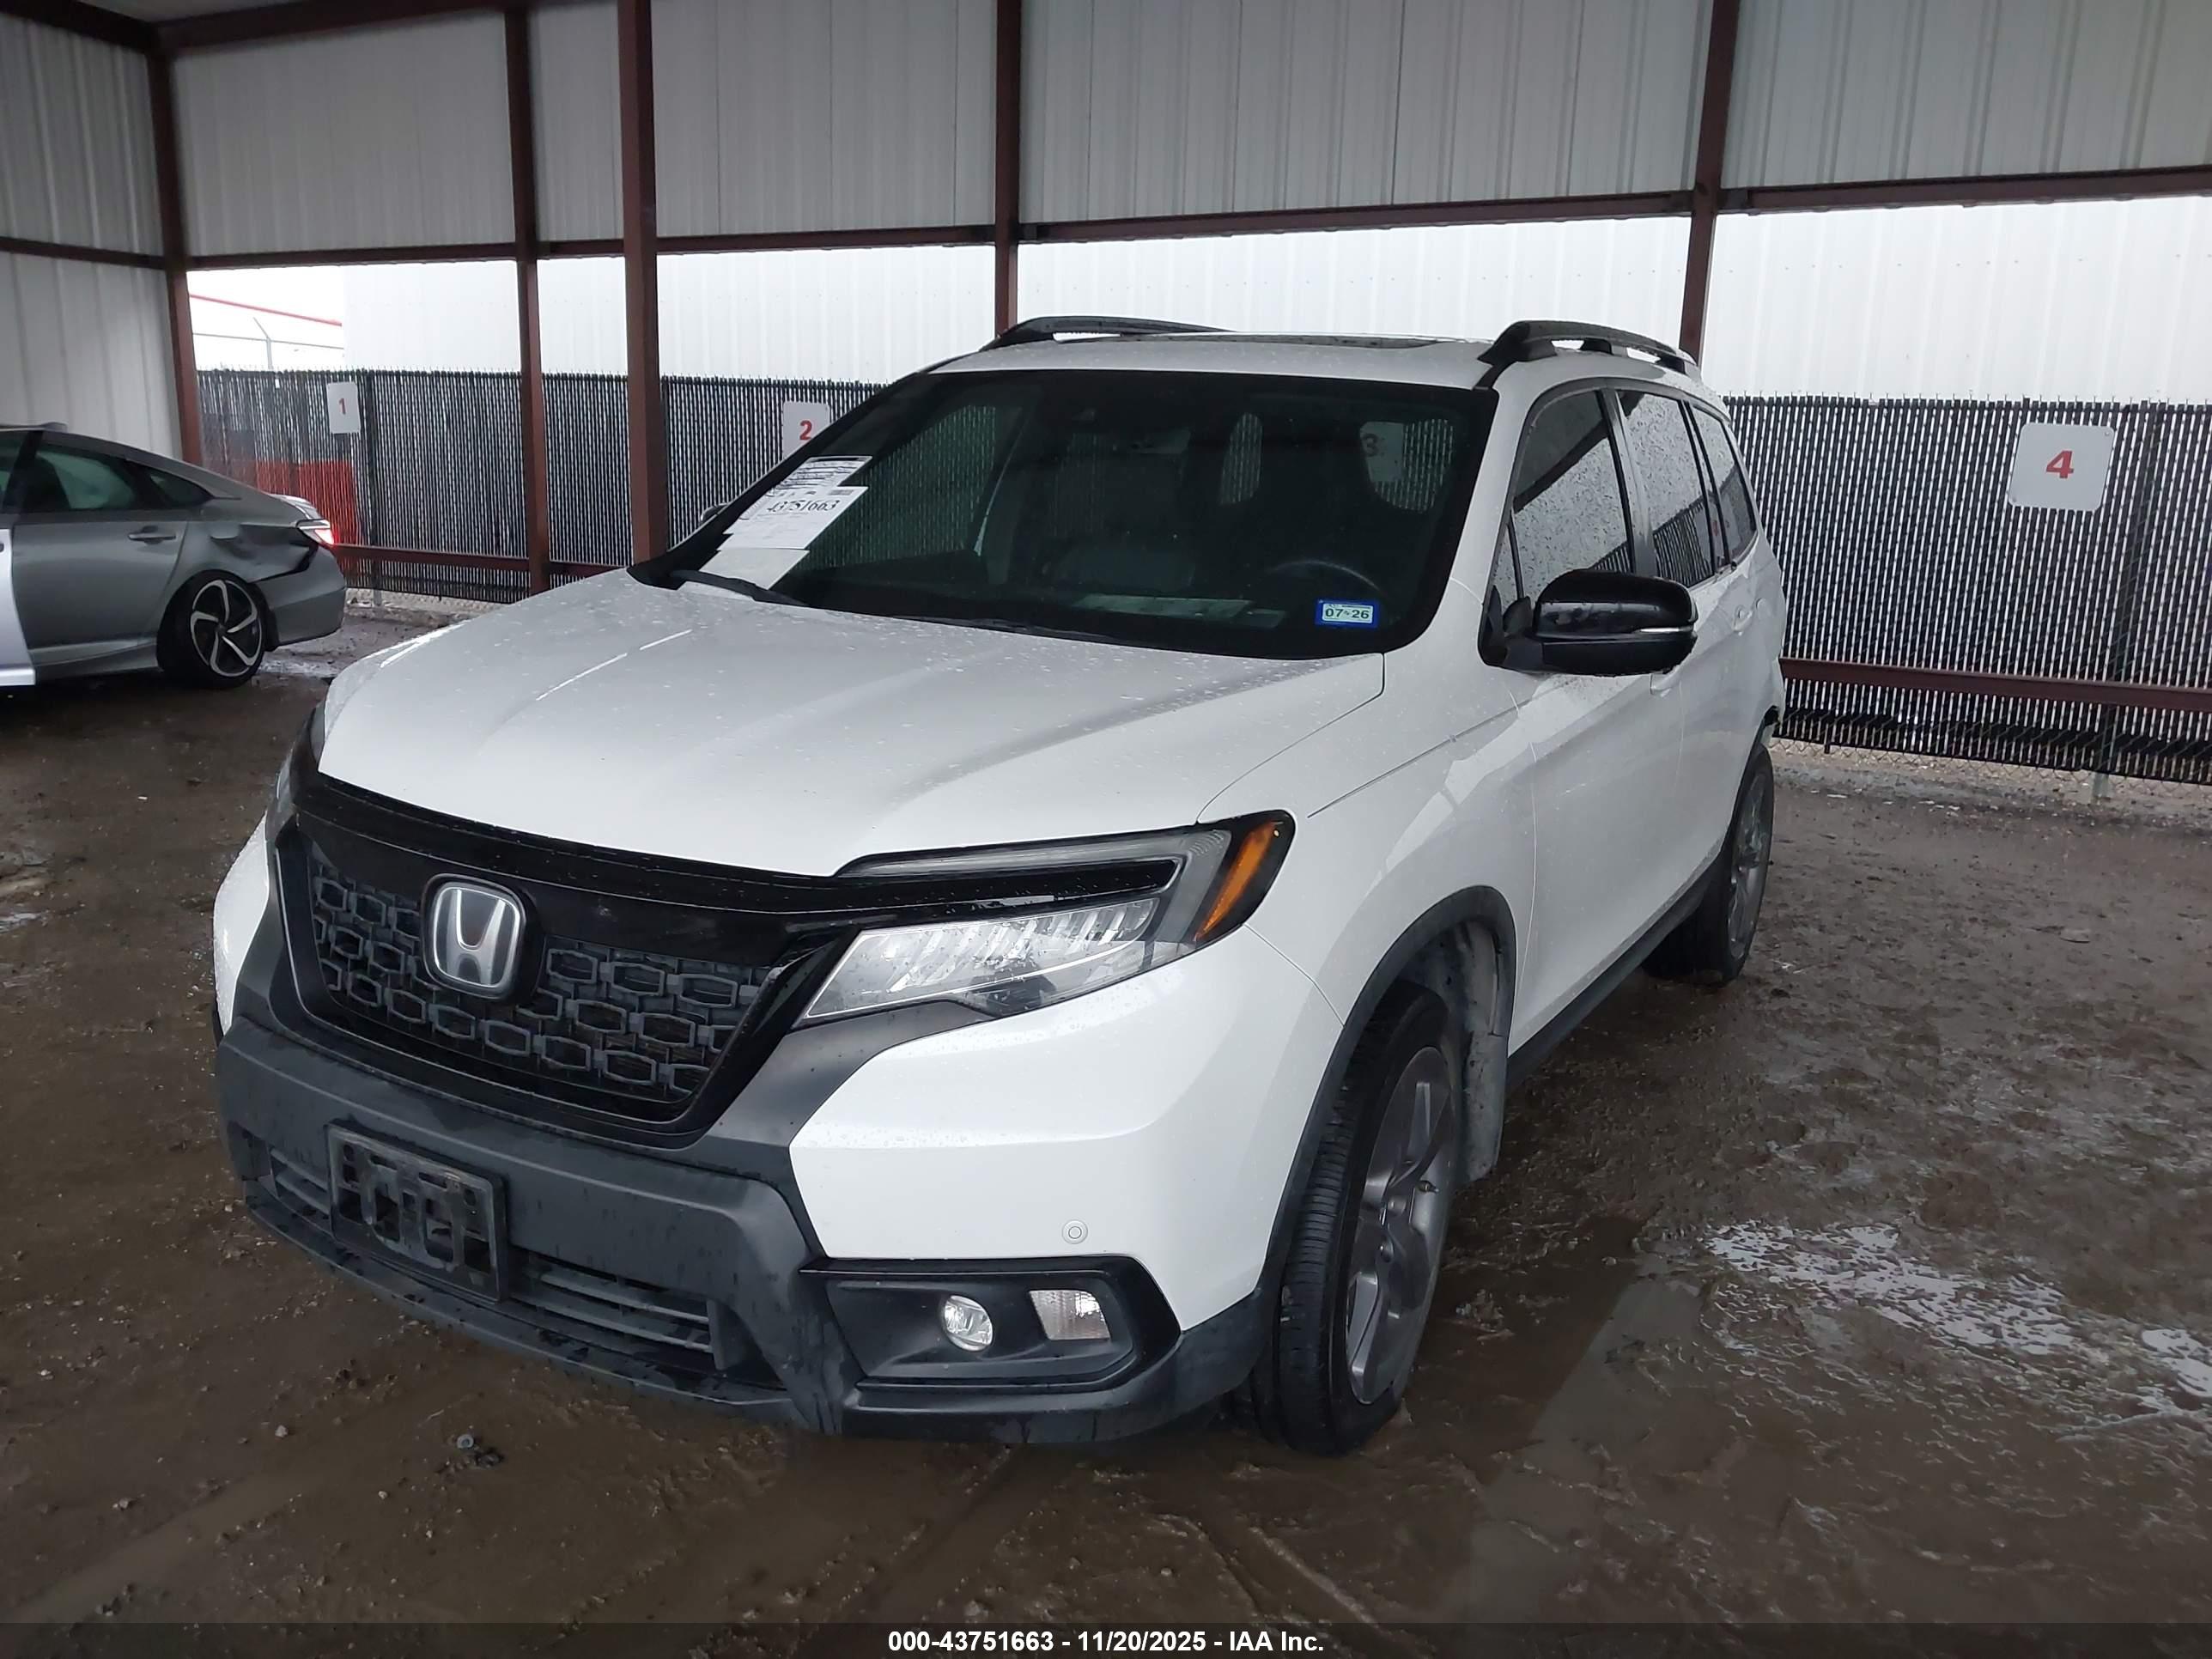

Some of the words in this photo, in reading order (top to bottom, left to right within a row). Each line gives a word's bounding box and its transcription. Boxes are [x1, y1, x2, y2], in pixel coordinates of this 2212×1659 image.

[338, 398, 347, 415] 1
[799, 420, 812, 441] 2
[1363, 433, 1379, 457] 3
[2045, 450, 2075, 479] 4
